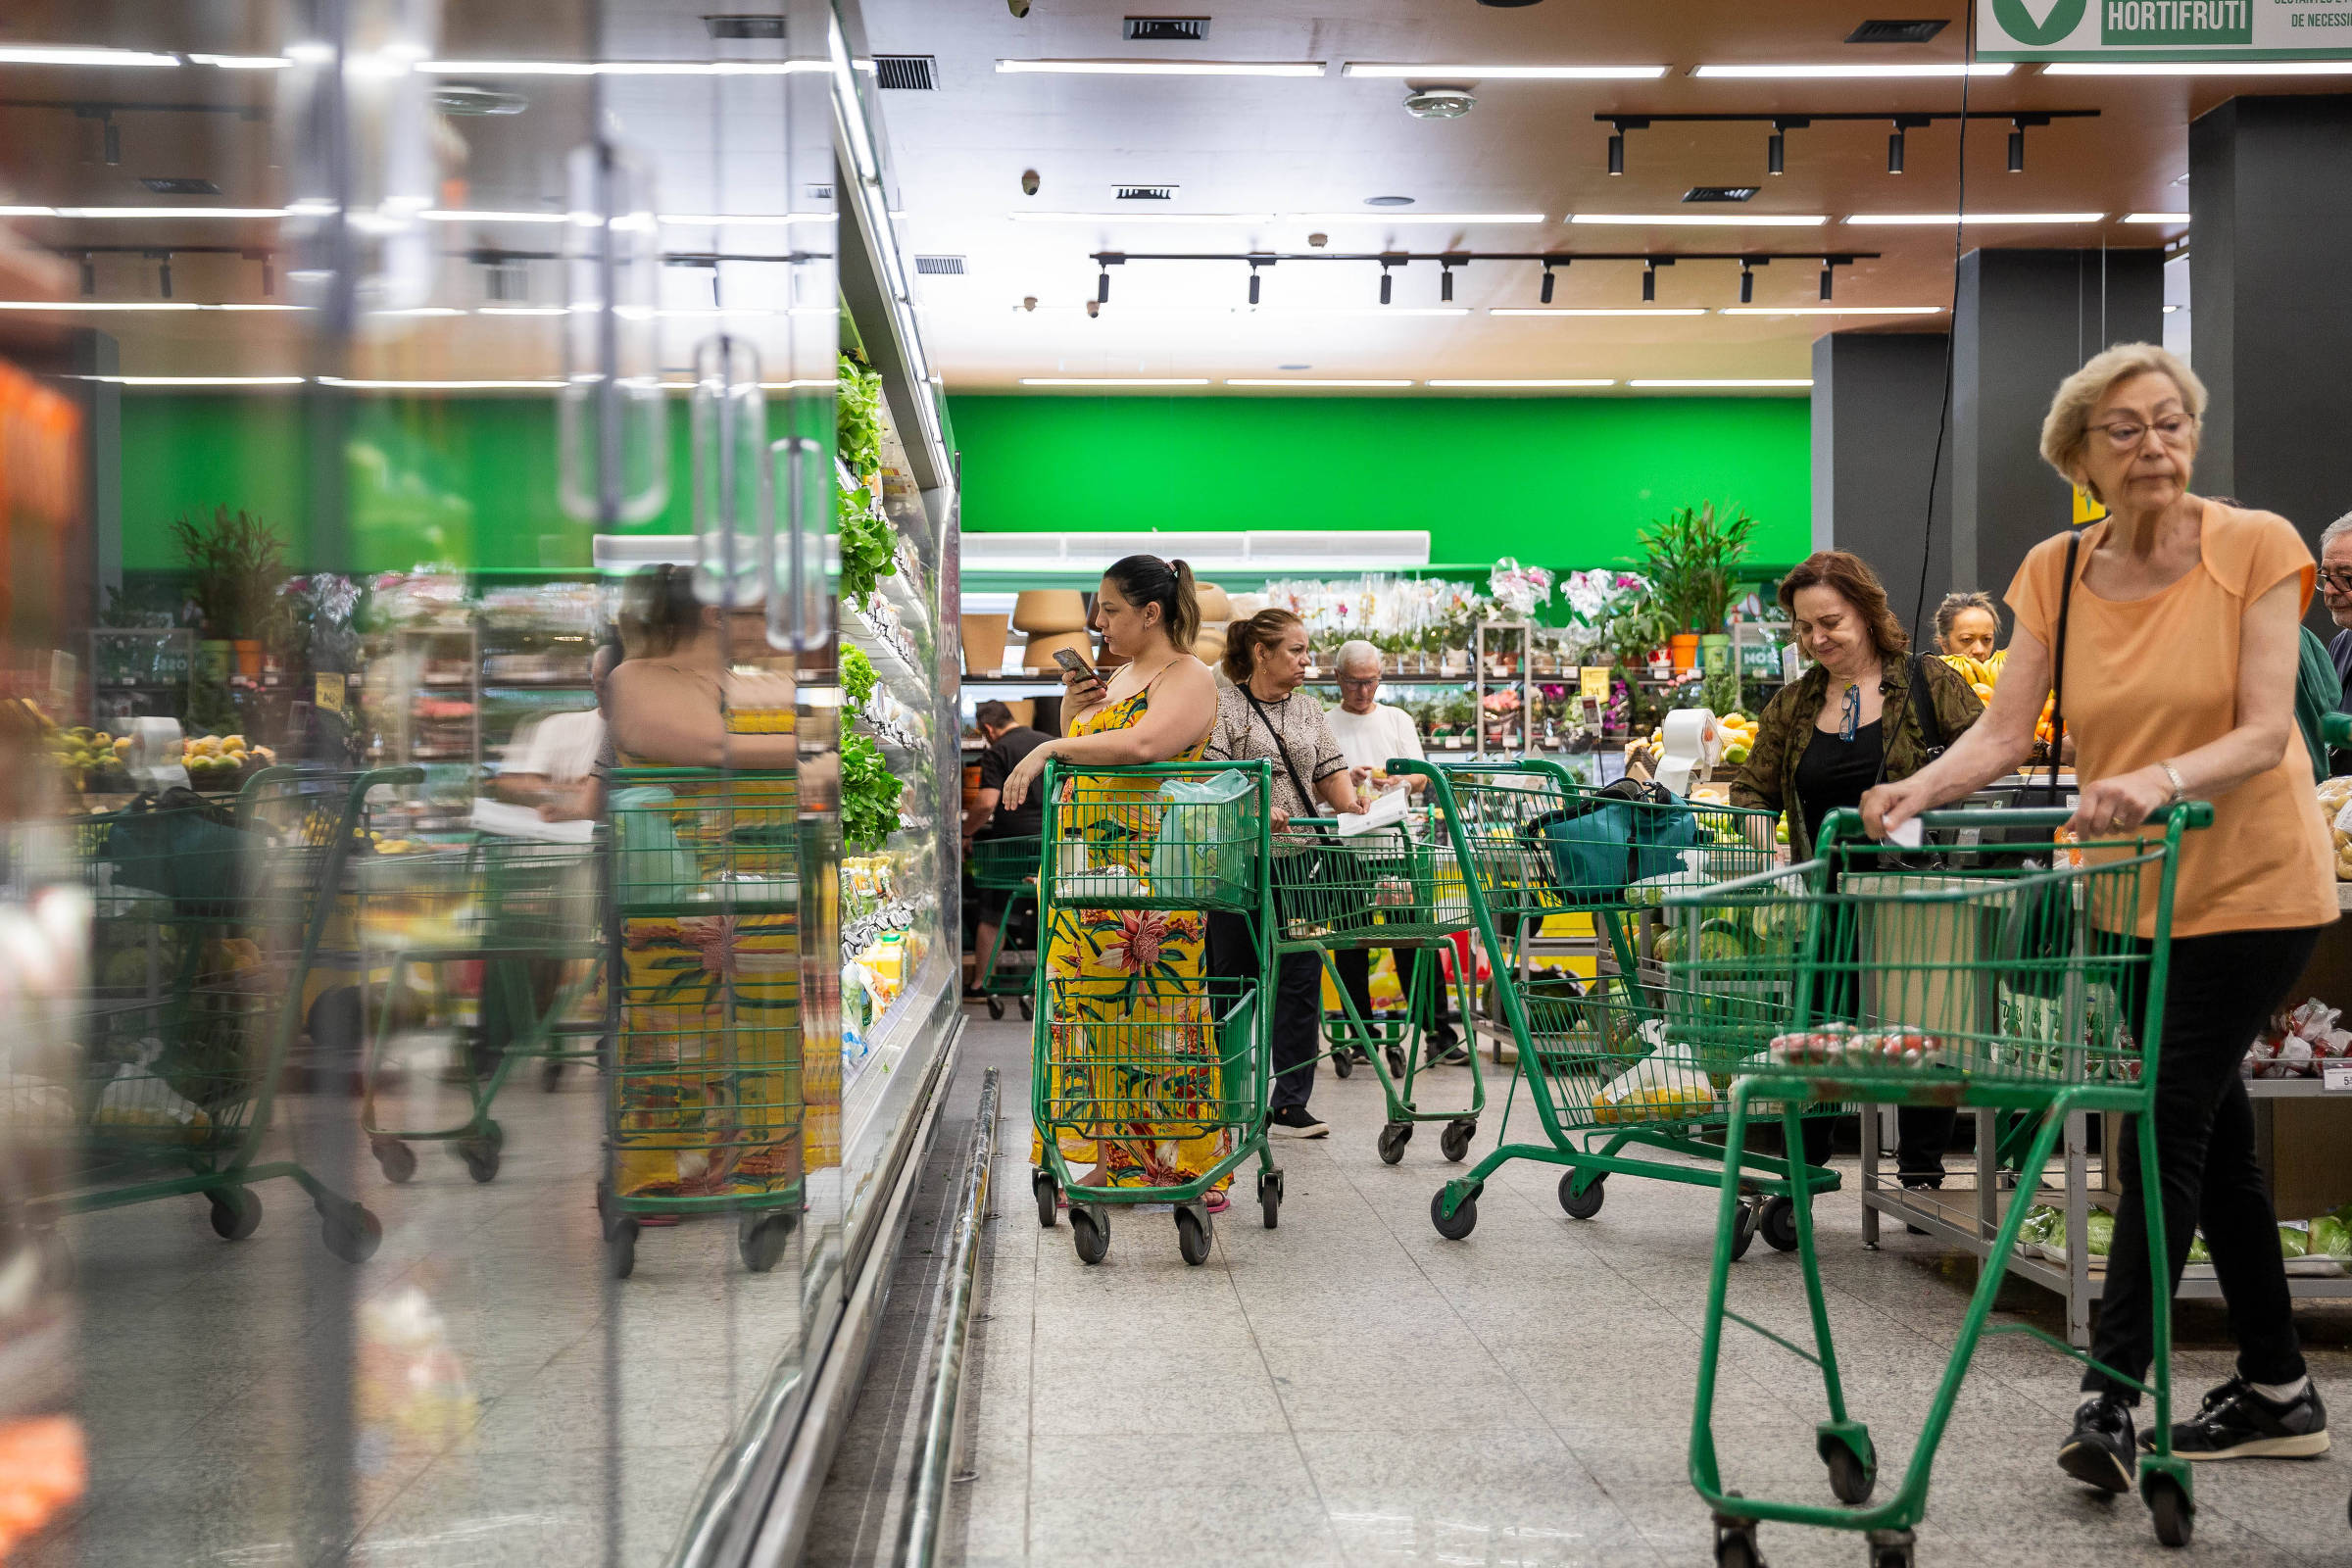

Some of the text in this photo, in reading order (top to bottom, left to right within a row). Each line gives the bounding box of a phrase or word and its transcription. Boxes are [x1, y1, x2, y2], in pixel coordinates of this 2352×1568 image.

[2108, 0, 2245, 29] HORTIFRUTI
[2291, 13, 2352, 27] DE NECESSI
